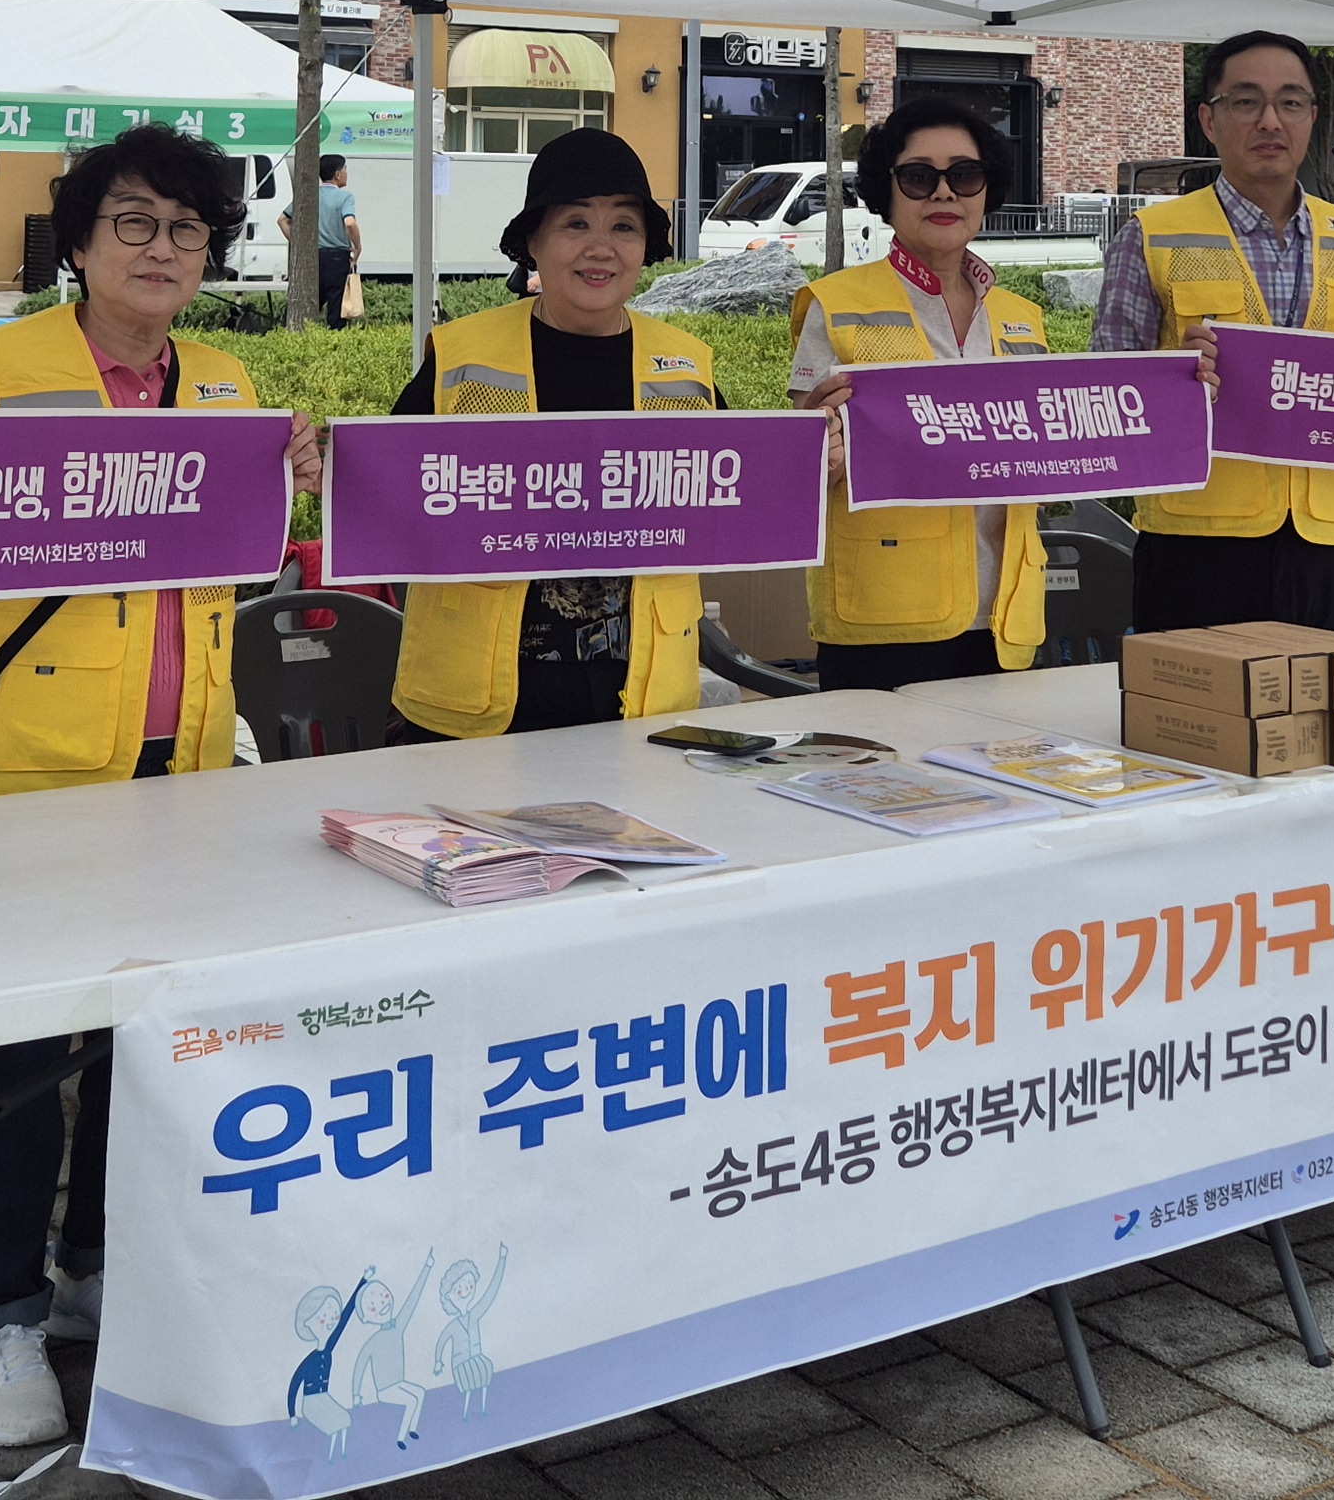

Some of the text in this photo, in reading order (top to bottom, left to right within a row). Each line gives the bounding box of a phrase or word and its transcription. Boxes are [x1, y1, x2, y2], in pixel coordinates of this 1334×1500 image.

[906, 384, 1152, 446] 행복한 인생, 함께해요
[62, 450, 206, 519] 함께해요
[420, 448, 742, 516] 행복한 인생, 함께해요
[967, 454, 1119, 480] 송도4동 지역사회보장협의체
[0, 539, 147, 568] 지역사회보장협의체
[480, 526, 686, 554] 송도4동 지역사회보장협의체
[201, 1054, 433, 1216] 우리
[479, 982, 787, 1151] 주변에
[823, 940, 995, 1070] 복지
[702, 1113, 881, 1219] 송도4동
[890, 1030, 1214, 1168] 행정복지센터에서
[1221, 1005, 1329, 1081] 도움이
[1149, 1193, 1199, 1229] 송도4동
[1203, 1169, 1284, 1213] 행정복지센터
